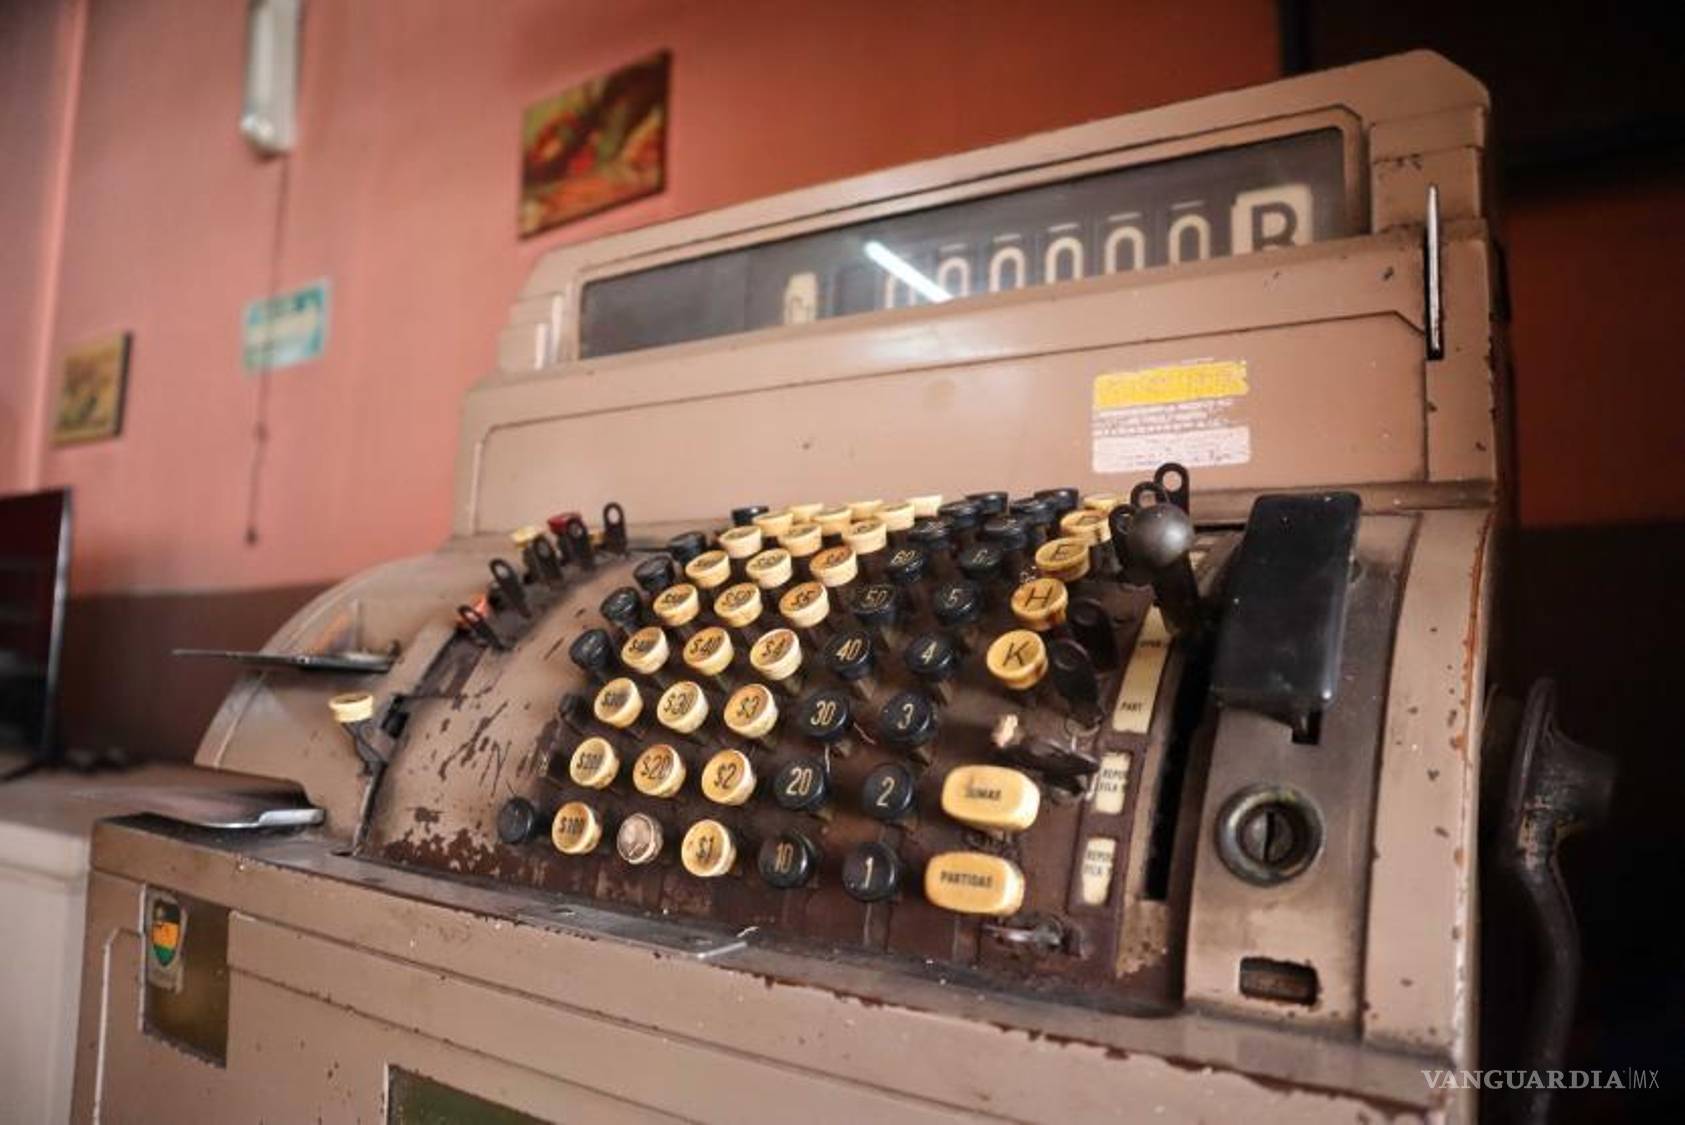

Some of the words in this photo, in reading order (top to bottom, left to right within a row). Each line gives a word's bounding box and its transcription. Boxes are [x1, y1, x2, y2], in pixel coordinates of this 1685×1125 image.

[1023, 586, 1052, 609] H
[837, 640, 861, 661] 40
[921, 641, 936, 664] 4
[1002, 641, 1030, 667] K
[810, 700, 836, 726] 30
[898, 703, 914, 729] 3
[714, 762, 737, 789] $2
[786, 768, 812, 796] 20
[876, 776, 895, 807] 2
[773, 843, 793, 873] 10
[864, 856, 874, 890] 1
